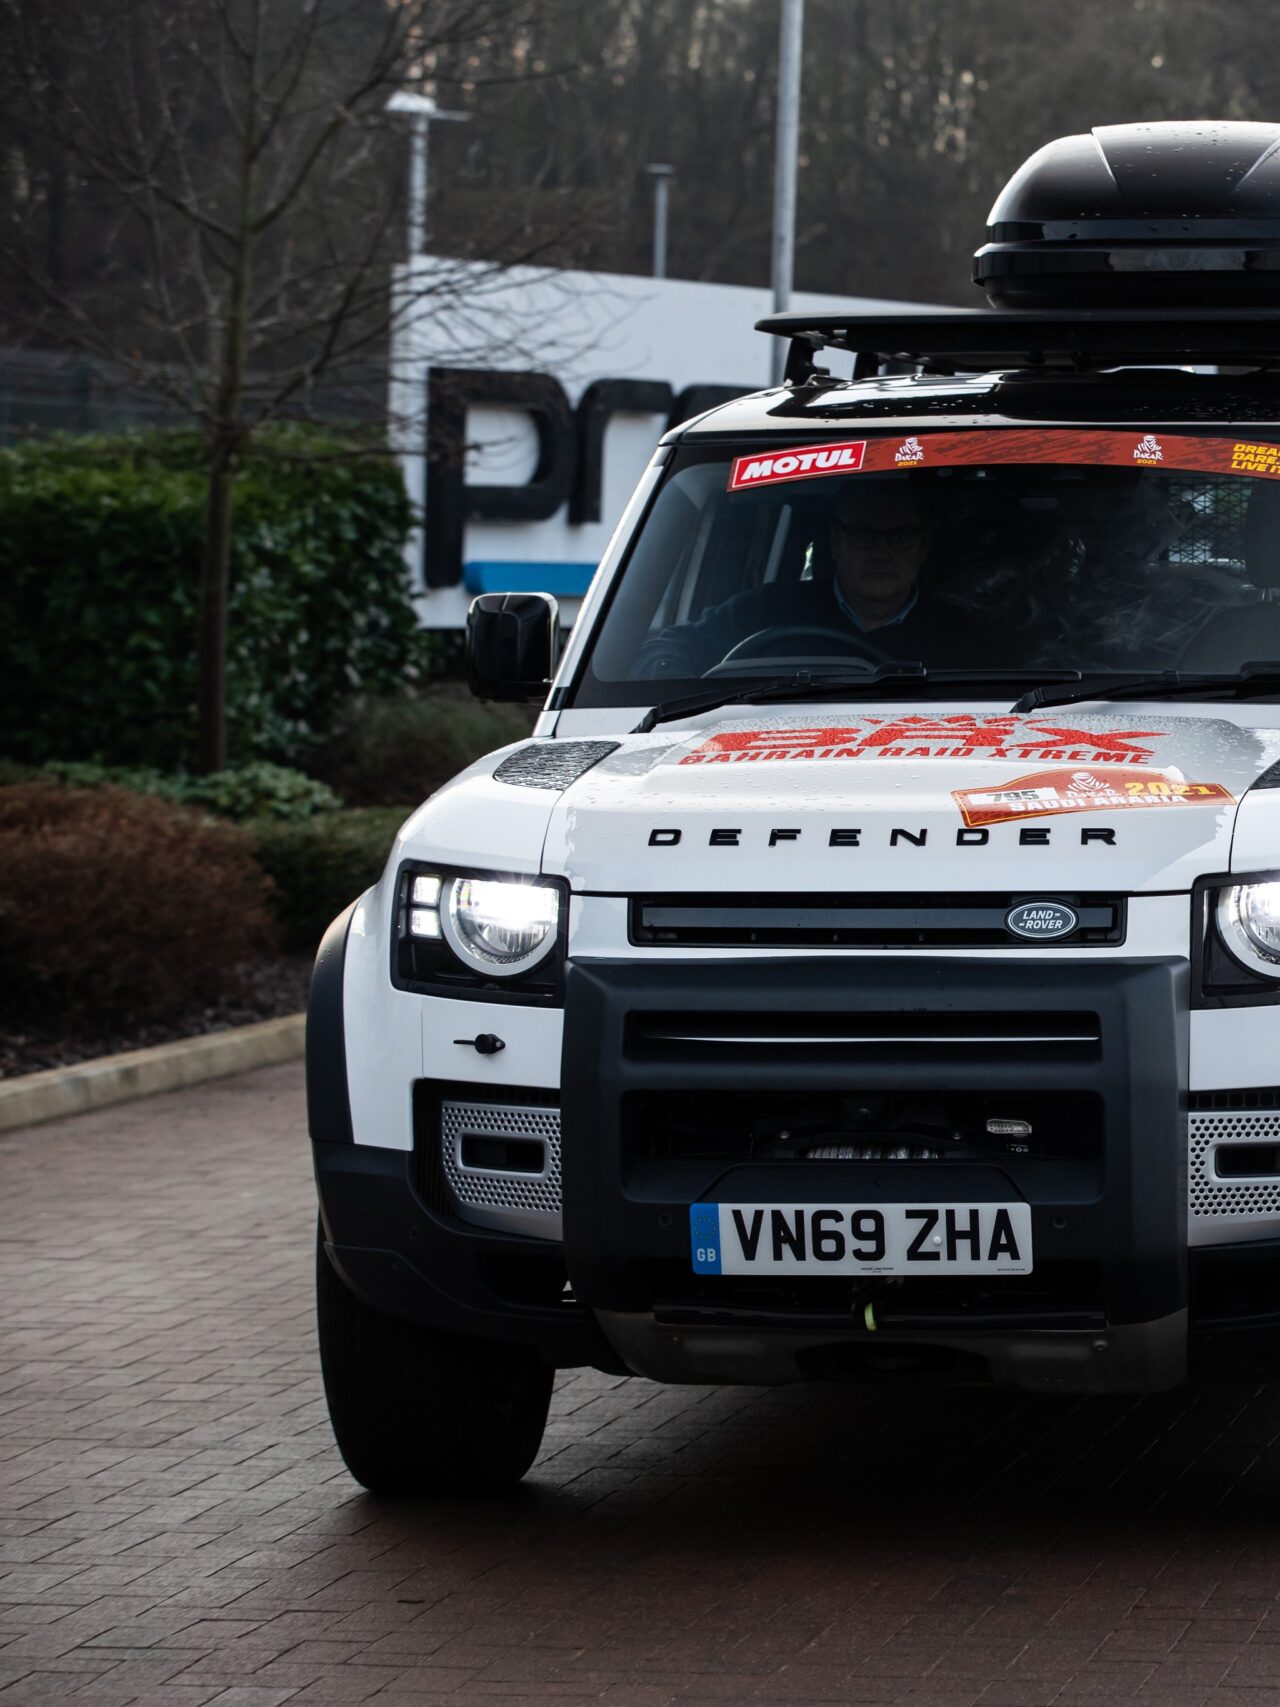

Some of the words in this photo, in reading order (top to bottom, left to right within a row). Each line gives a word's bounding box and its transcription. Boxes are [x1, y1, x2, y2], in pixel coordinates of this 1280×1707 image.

[895, 451, 925, 461] DAKAR
[1133, 449, 1164, 460] DAKAR
[1232, 452, 1280, 465] DARE.
[740, 449, 856, 481] MOTUL
[1231, 460, 1269, 472] LIVE
[424, 366, 770, 588] pr
[678, 748, 866, 765] BAHRAIN
[877, 747, 976, 758] RAID
[986, 748, 1155, 764] XTREME
[1009, 797, 1084, 811] SAUDI
[1093, 795, 1189, 806] ARABIA
[648, 828, 1118, 848] DEFENDER
[731, 1209, 886, 1261] VN69
[904, 1208, 1021, 1261] ZHA
[696, 1248, 716, 1262] GB
